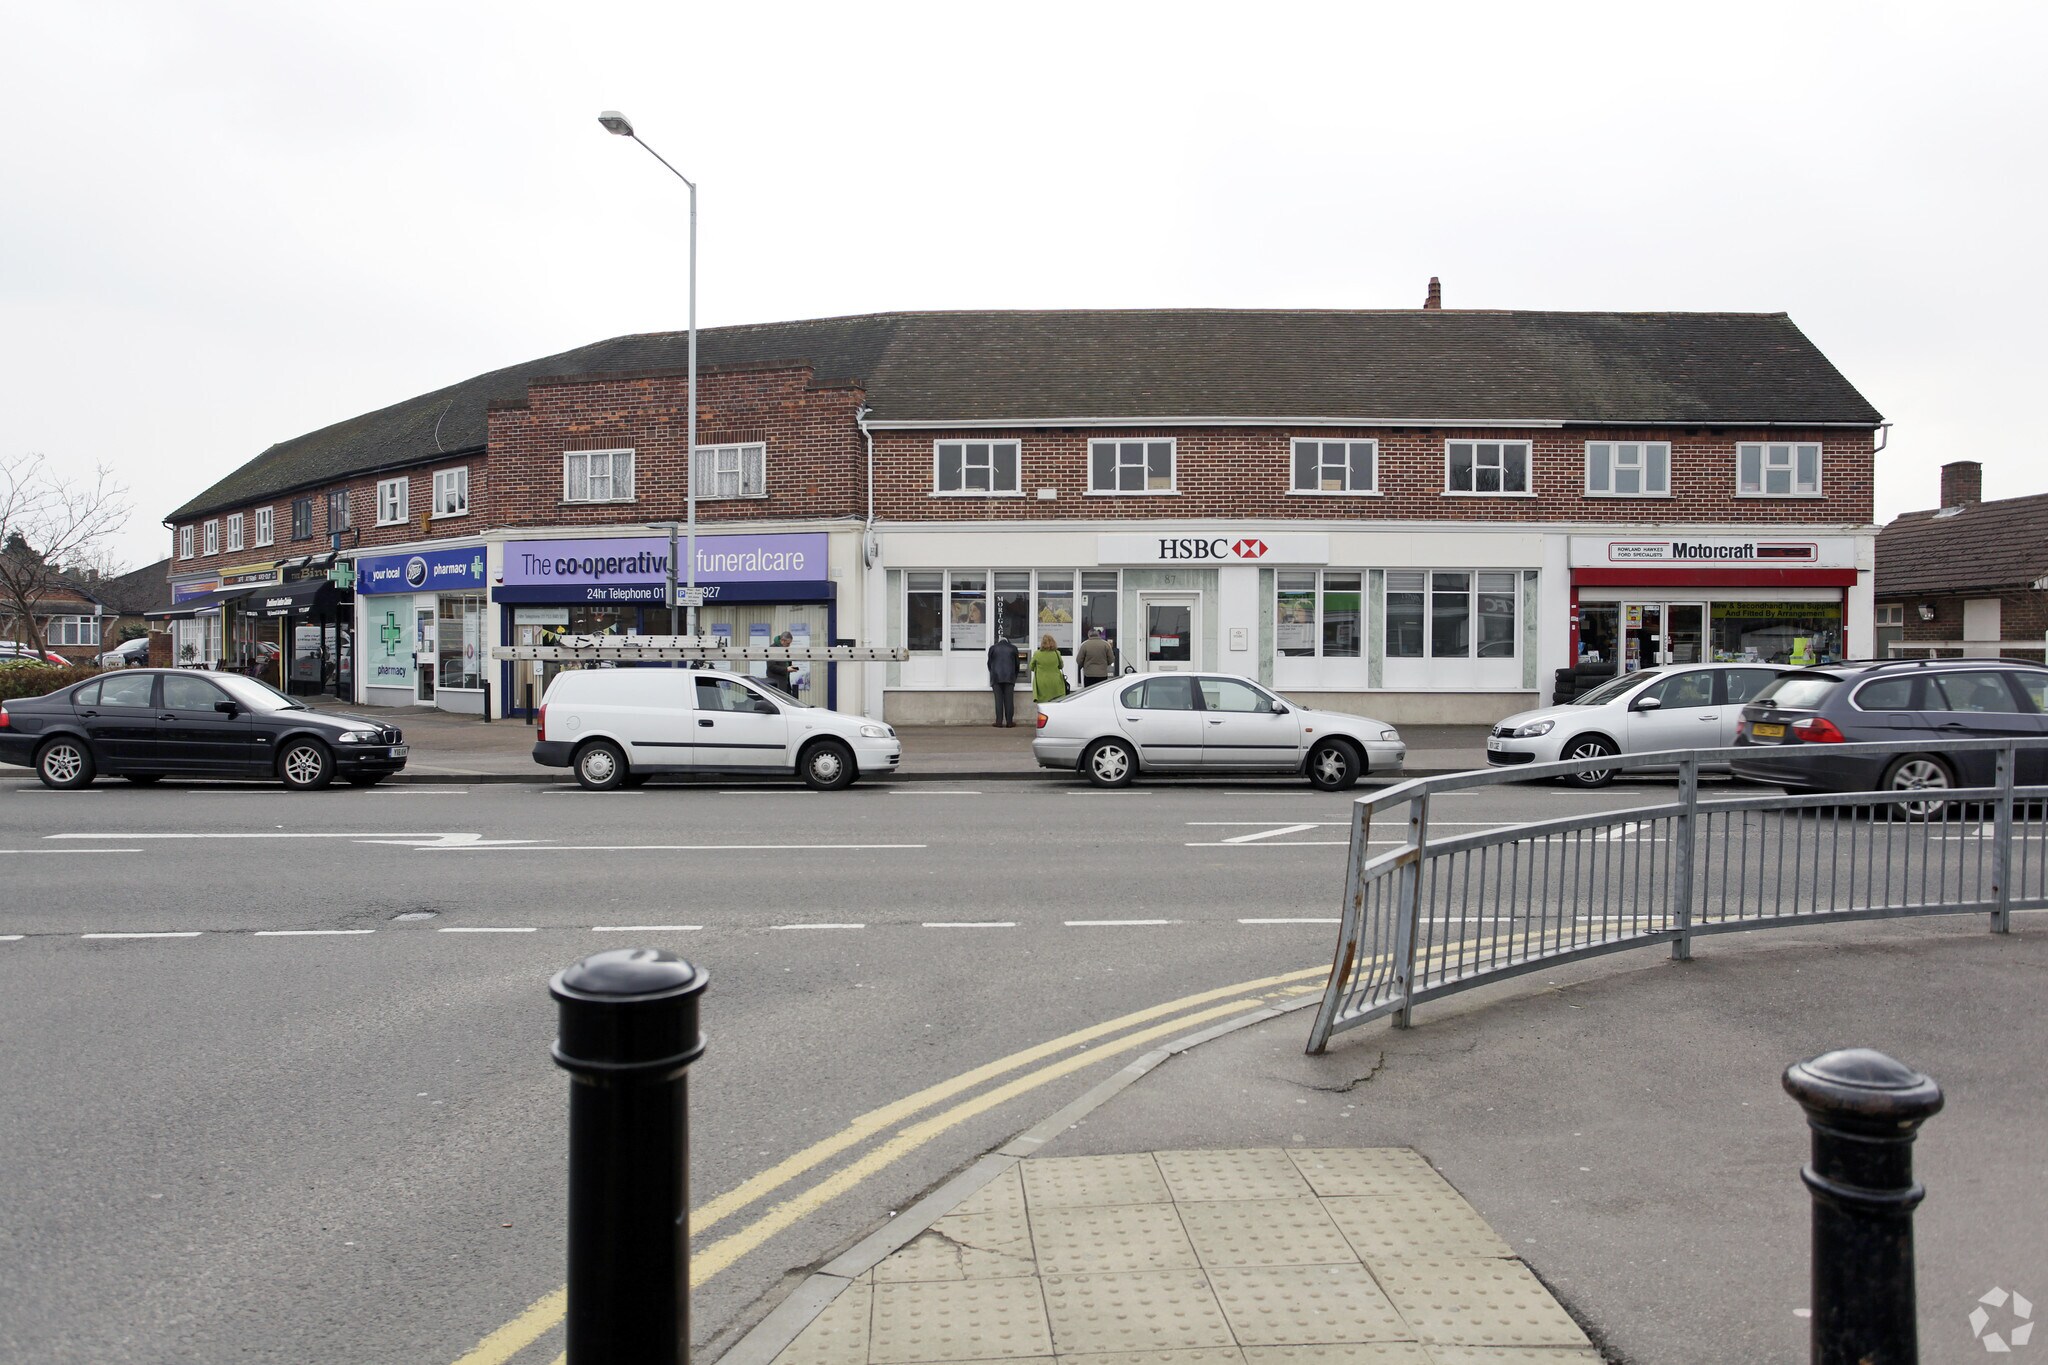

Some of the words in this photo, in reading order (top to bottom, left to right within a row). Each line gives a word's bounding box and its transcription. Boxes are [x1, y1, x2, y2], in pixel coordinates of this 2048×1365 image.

[1158, 538, 1229, 559] HSBC
[1672, 542, 1754, 559] Motorcraft
[521, 553, 551, 576] The
[696, 548, 805, 572] funeralcare
[372, 570, 386, 582] your
[386, 567, 400, 579] local
[433, 563, 467, 577] pharmacy
[1164, 575, 1176, 585] 87
[587, 588, 606, 599] 24hr
[608, 587, 652, 601] Telephone
[1786, 602, 1805, 610] Tyres
[1807, 602, 1840, 610] Supplied
[1766, 610, 1776, 618] By
[1777, 610, 1825, 618] Arrangement
[377, 665, 407, 678] pharmacy
